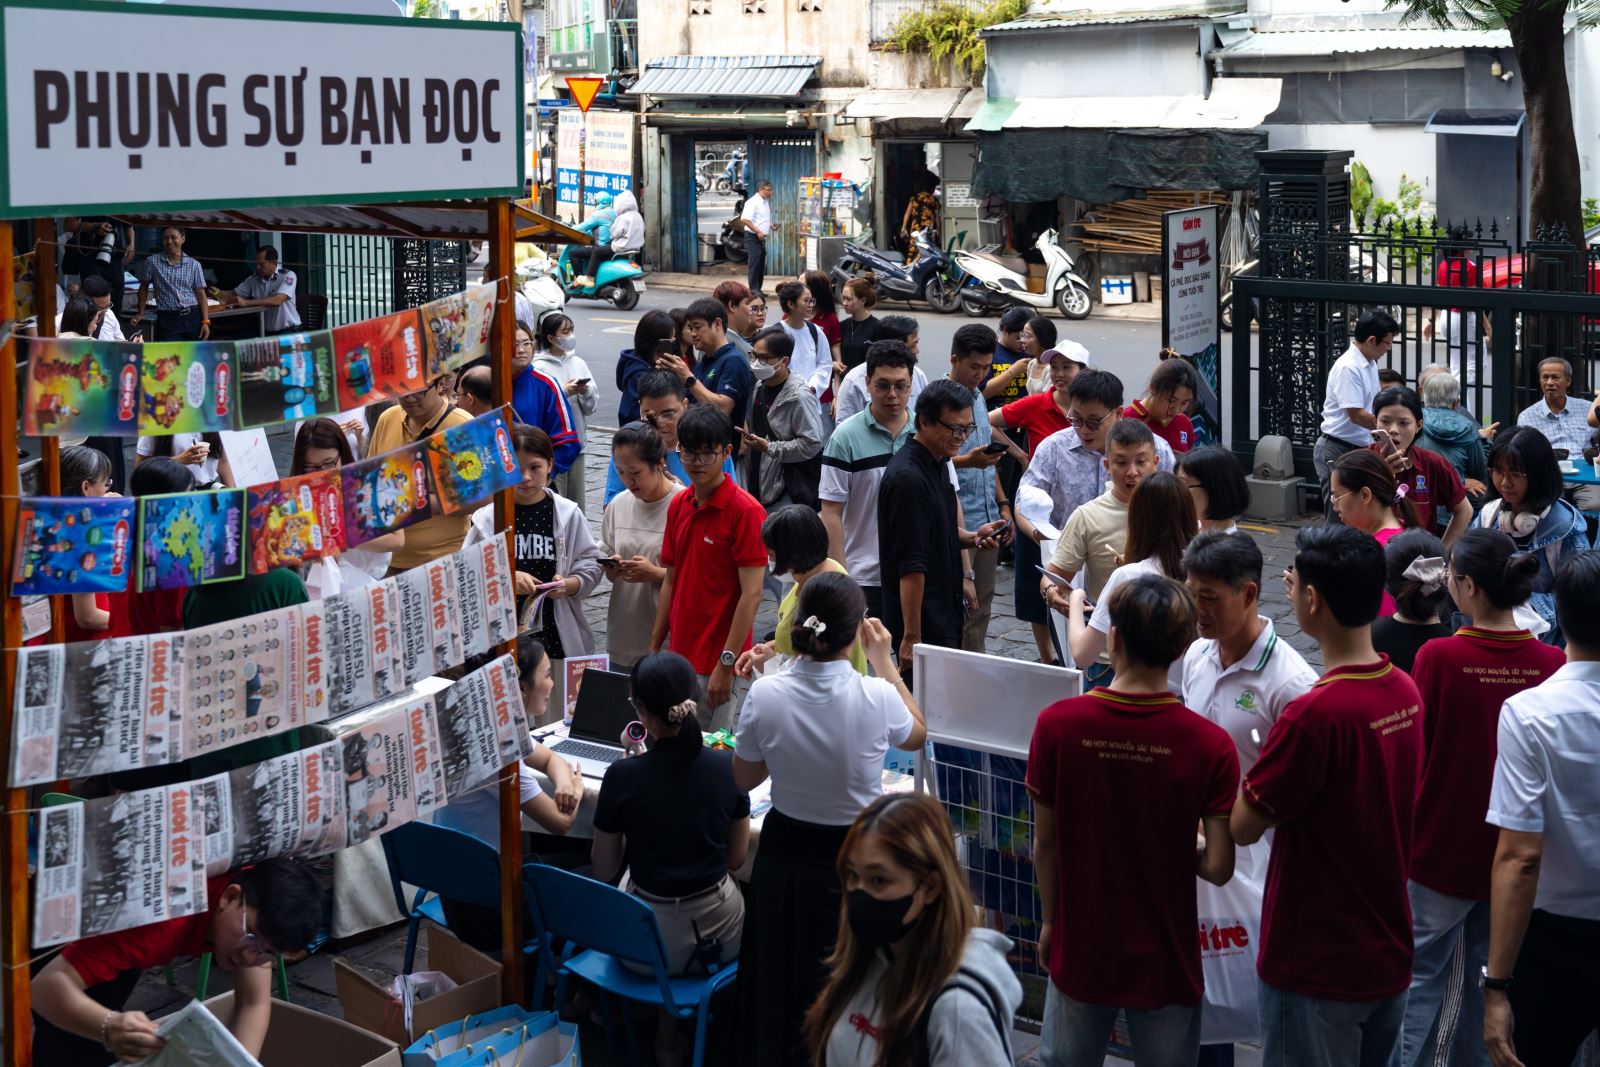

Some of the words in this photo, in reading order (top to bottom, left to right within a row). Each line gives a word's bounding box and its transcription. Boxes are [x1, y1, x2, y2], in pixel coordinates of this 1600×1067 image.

[34, 70, 227, 169] PHỤNG
[243, 67, 307, 165] SỰ
[322, 77, 410, 164] BẠN
[423, 78, 501, 161] ĐỌC
